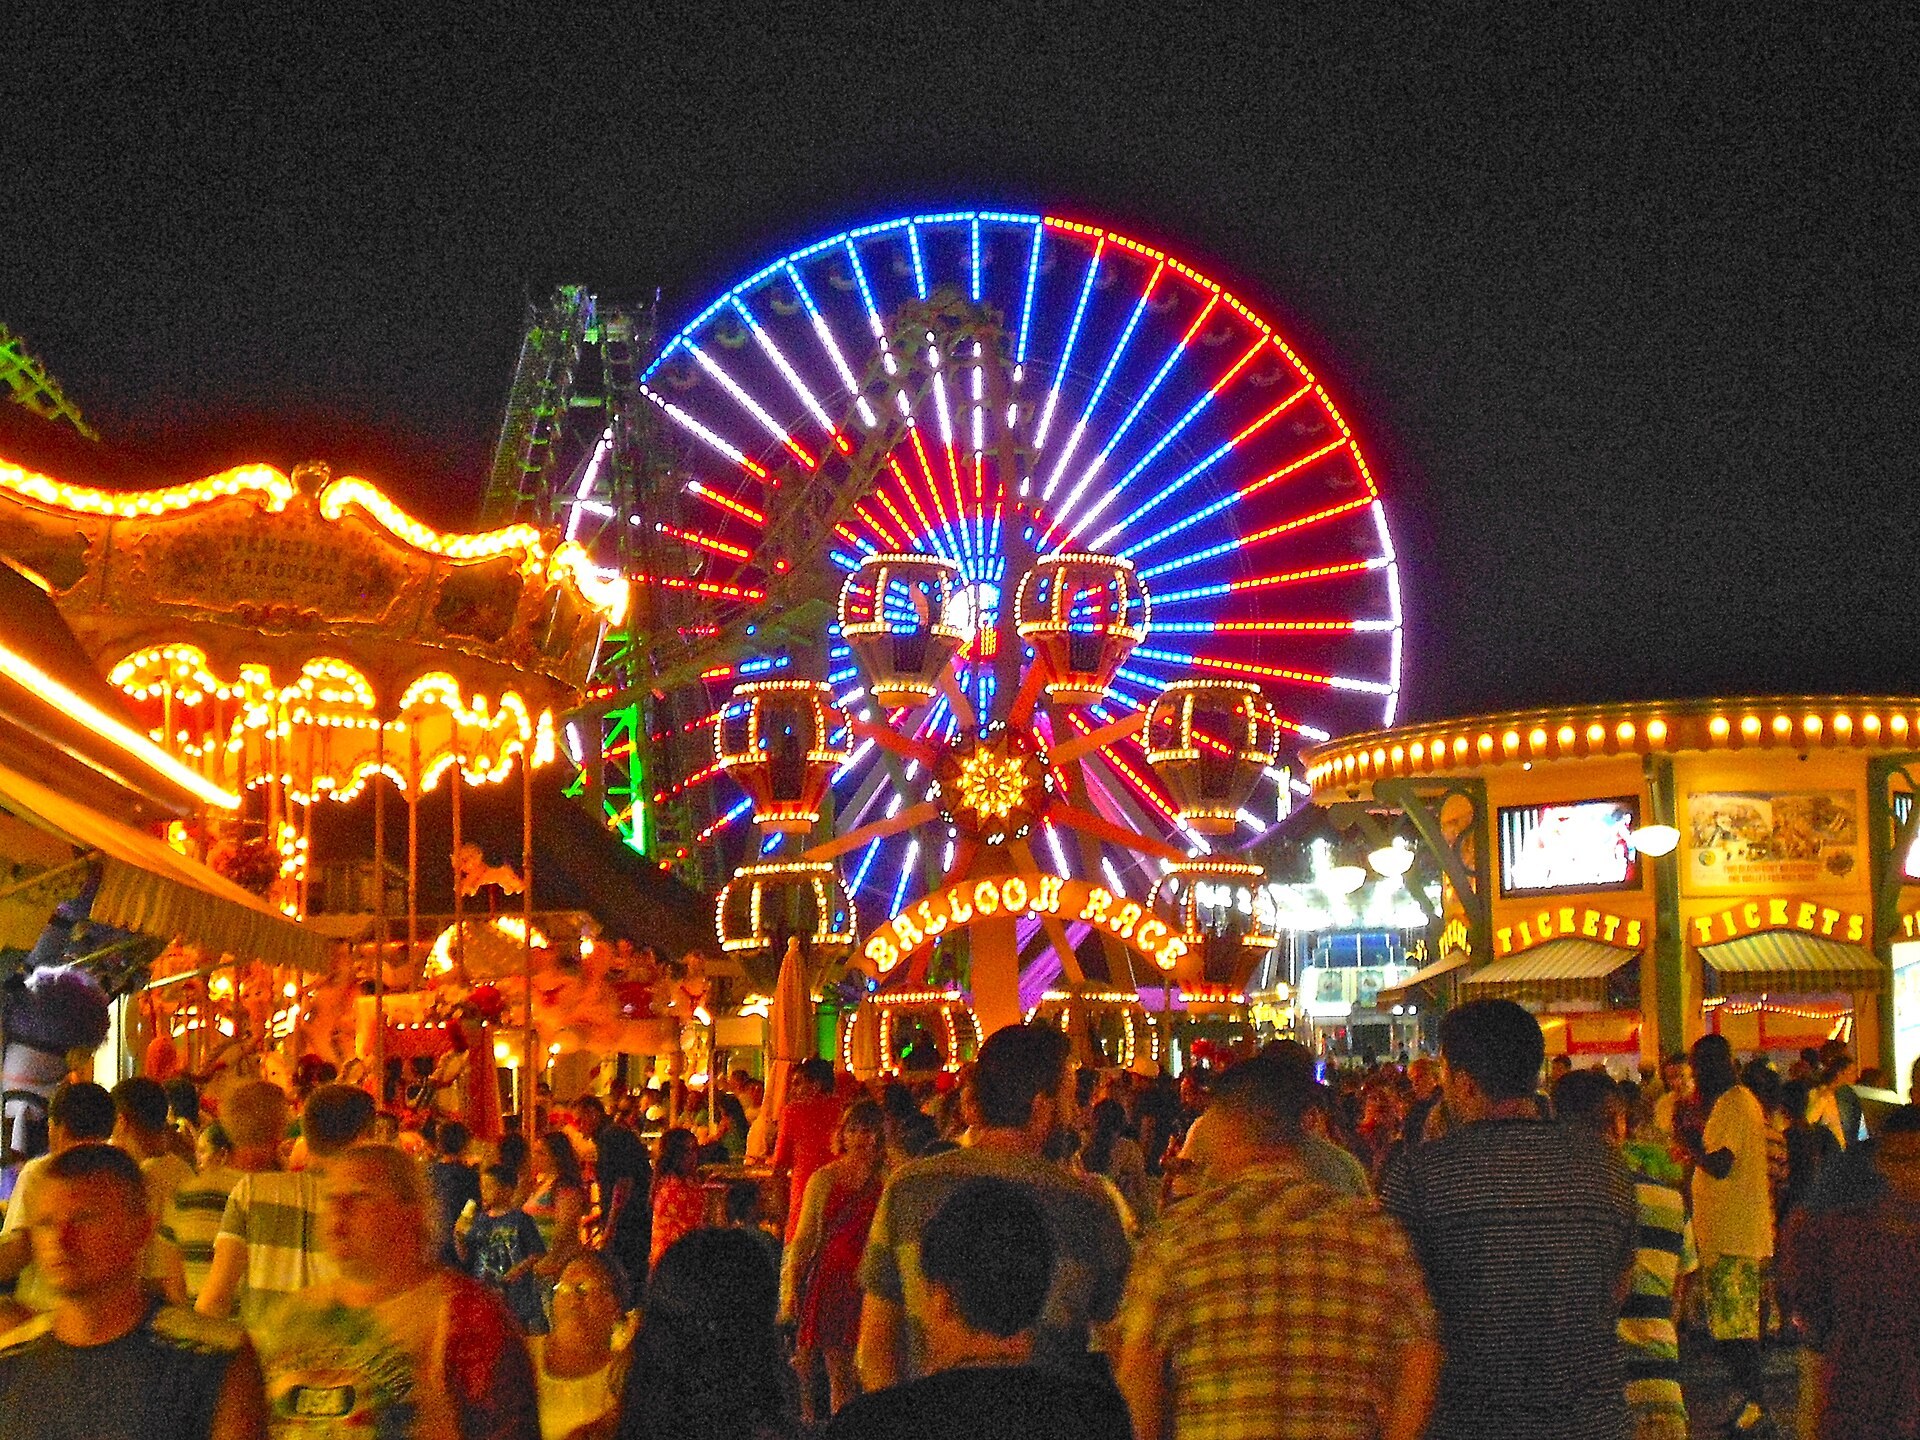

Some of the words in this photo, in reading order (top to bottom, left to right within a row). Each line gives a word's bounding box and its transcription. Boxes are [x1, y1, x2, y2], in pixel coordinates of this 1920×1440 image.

[864, 876, 1064, 973] BALLOON
[1079, 887, 1189, 970] RACE
[1496, 906, 1643, 952] TICKETS
[1694, 899, 1865, 944] TICKETS
